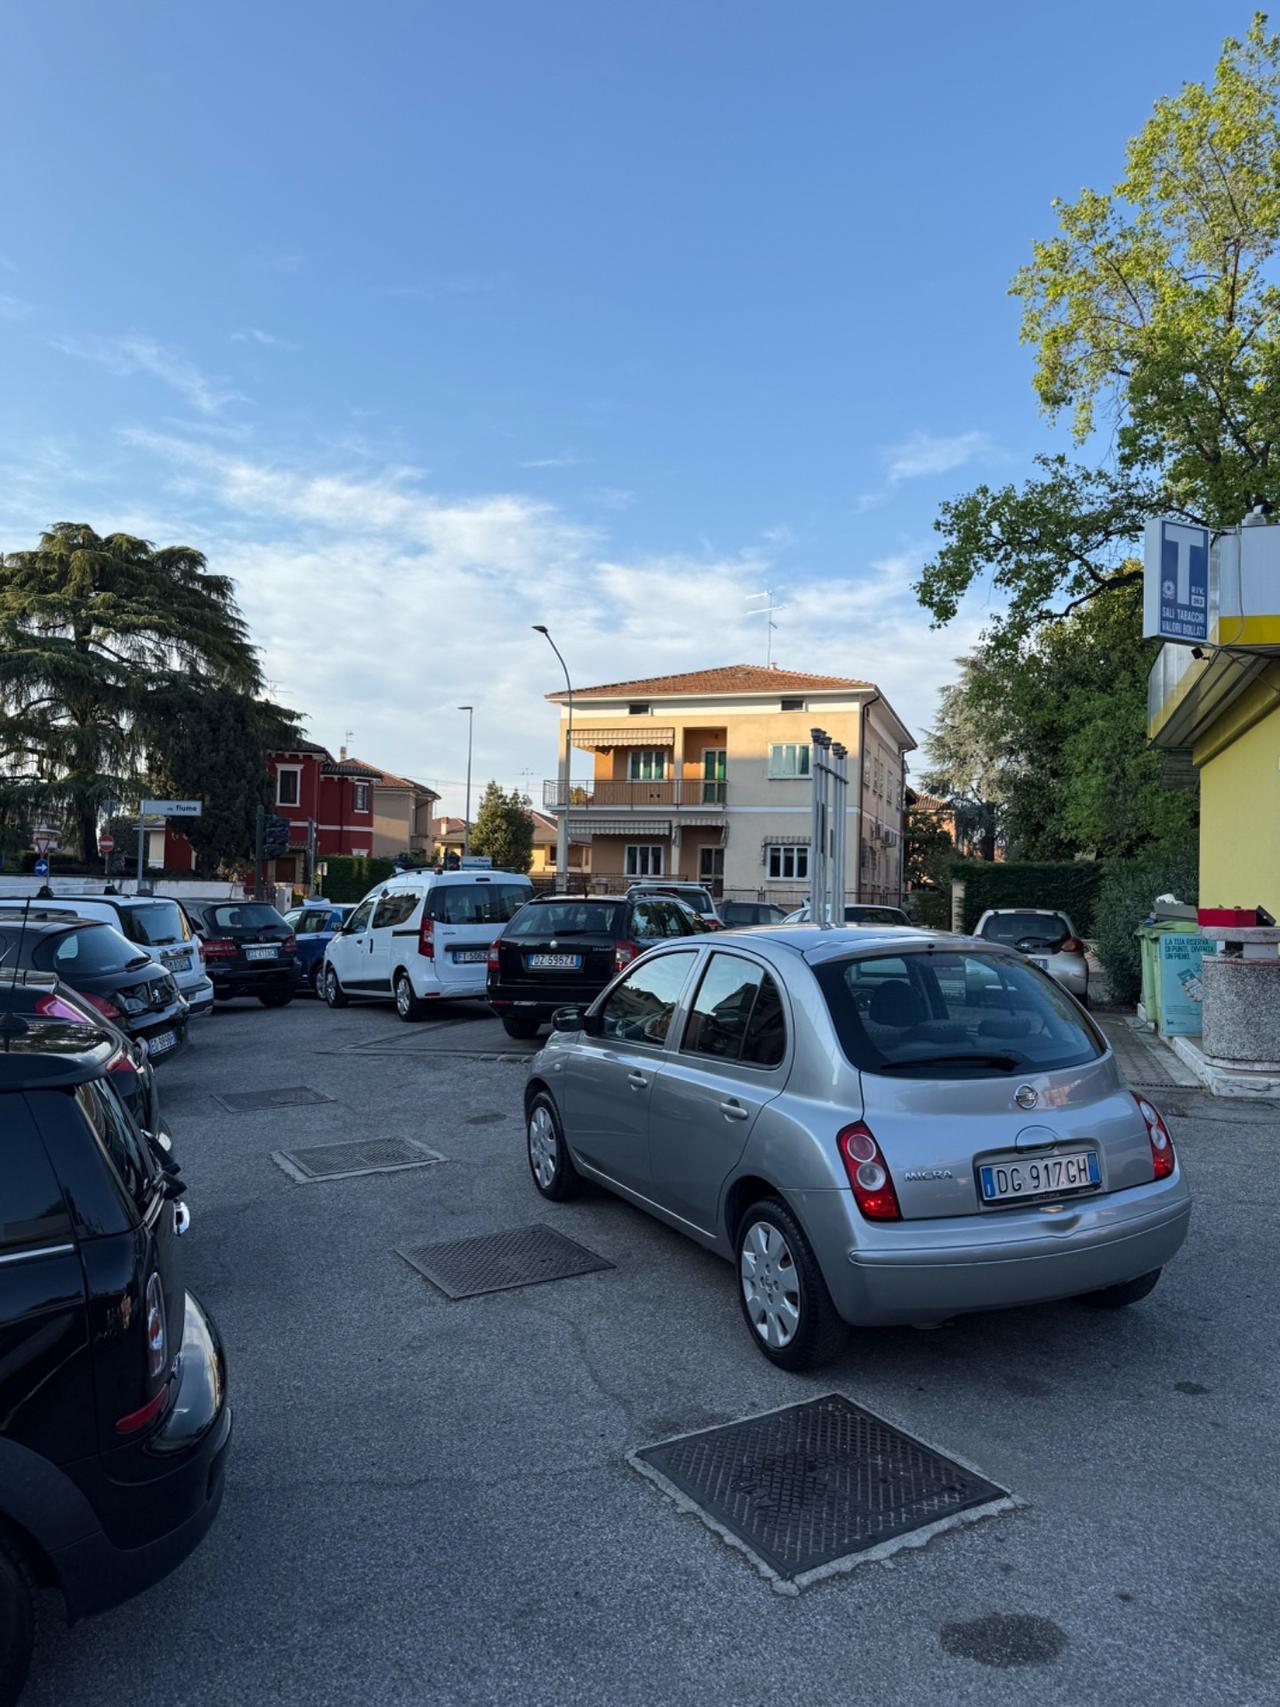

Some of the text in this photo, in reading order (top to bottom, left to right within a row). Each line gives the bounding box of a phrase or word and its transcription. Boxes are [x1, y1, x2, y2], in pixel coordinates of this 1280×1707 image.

[1165, 524, 1204, 605] T
[1162, 606, 1205, 623] SALI TABACCHI
[1162, 620, 1205, 637] VALORI BOLLATI
[904, 1170, 952, 1182] MICRA
[997, 1168, 1022, 1194] DG
[1029, 1158, 1088, 1189] 917GH
